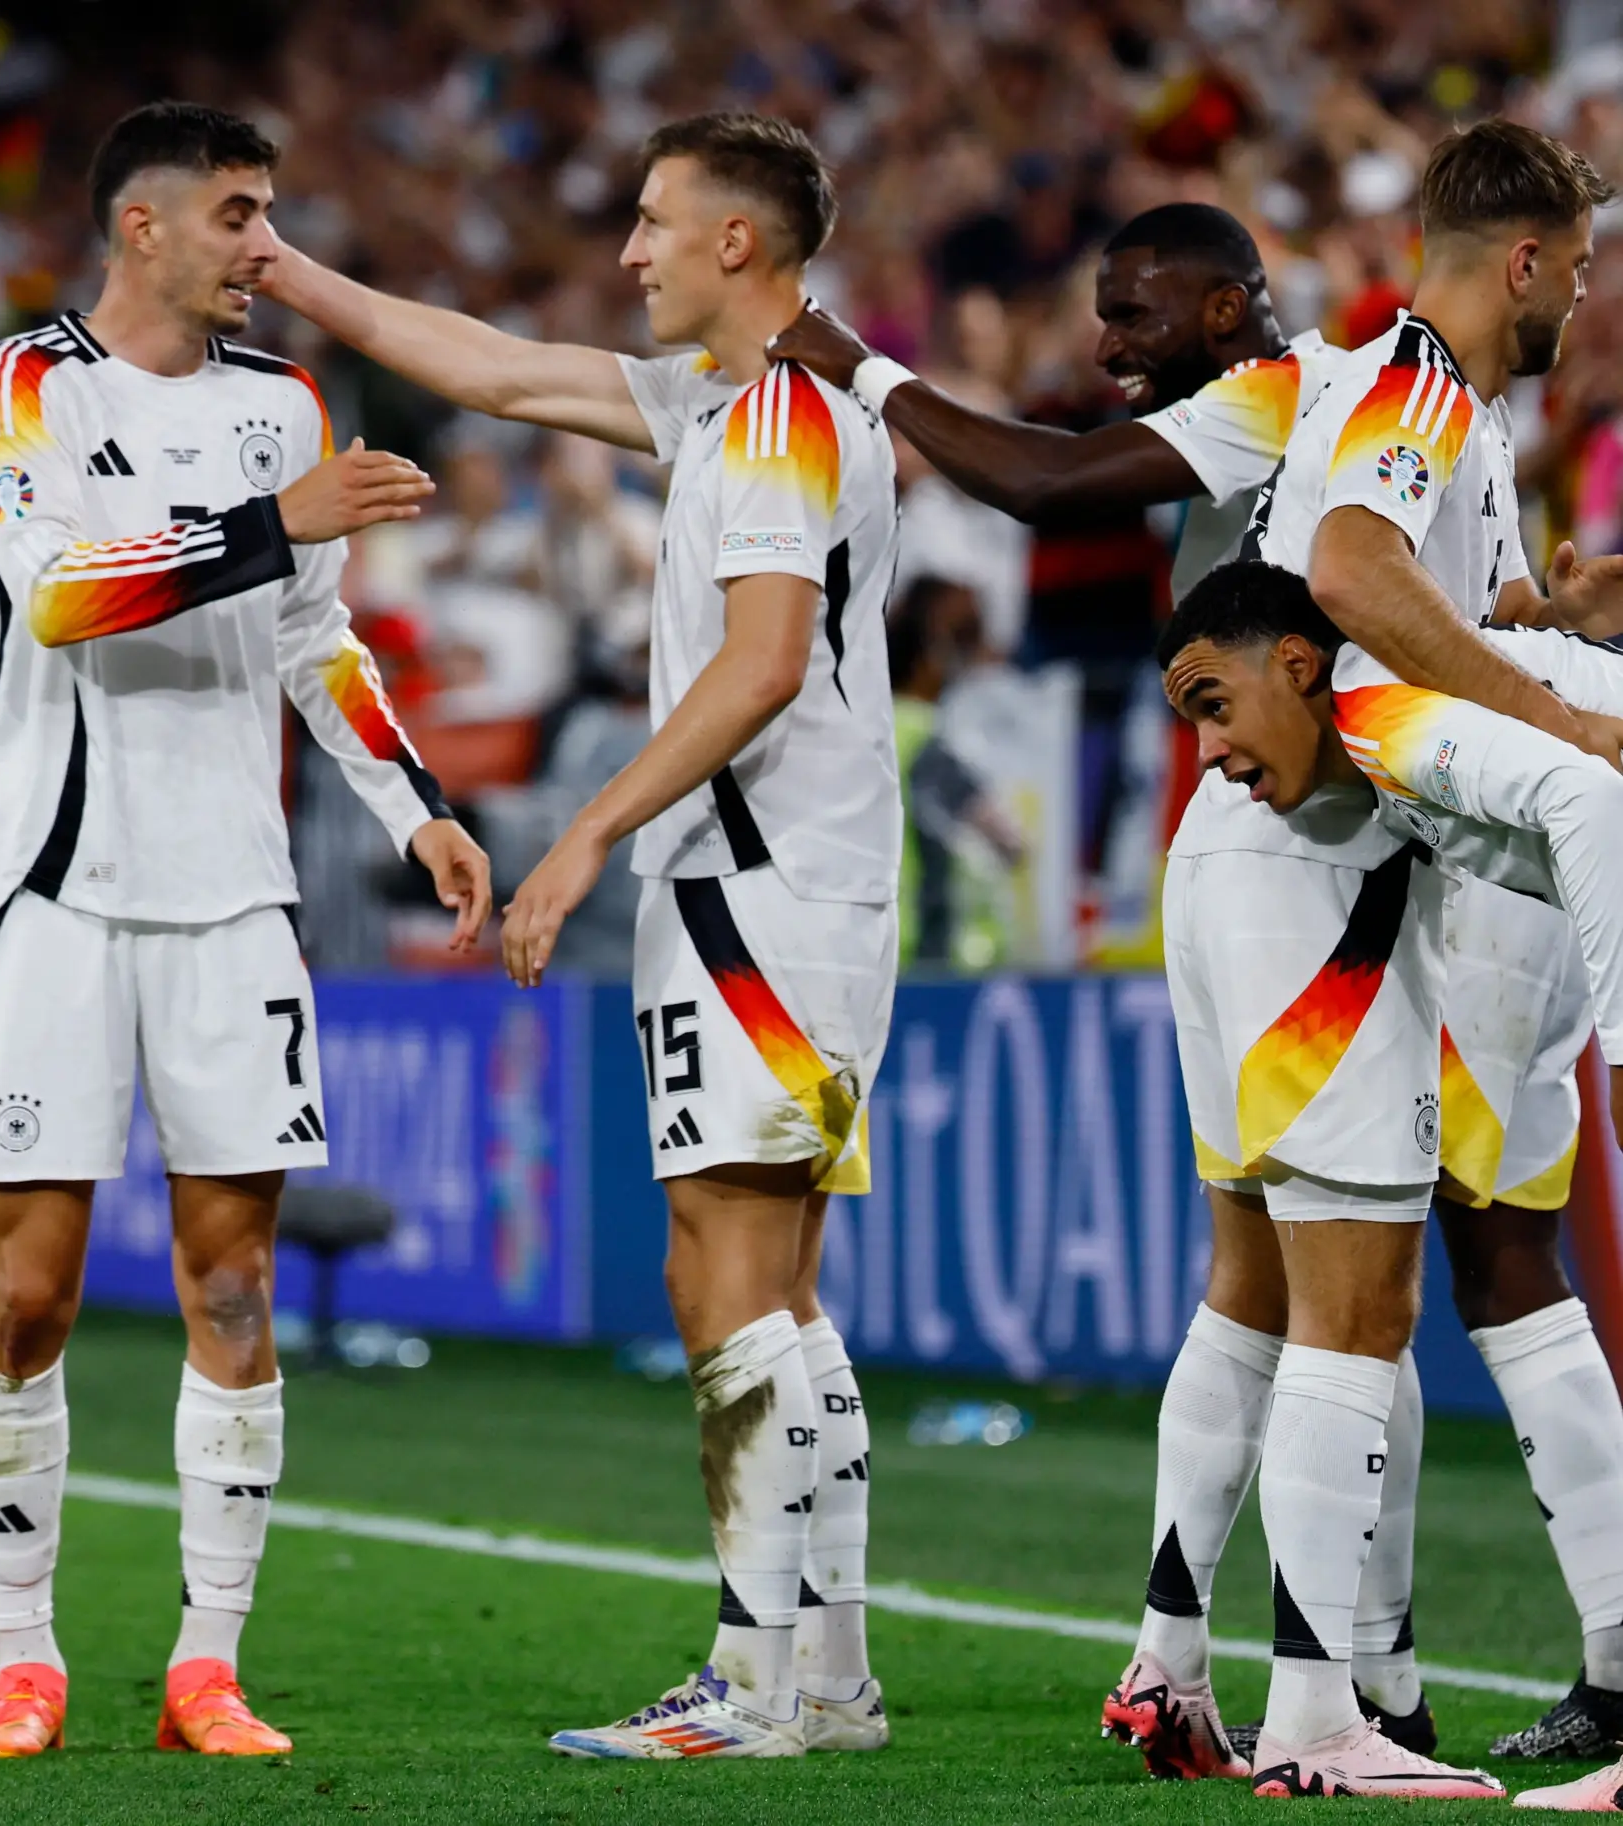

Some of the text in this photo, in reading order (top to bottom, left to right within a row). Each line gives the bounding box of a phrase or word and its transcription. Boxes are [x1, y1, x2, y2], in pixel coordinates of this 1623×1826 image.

[265, 998, 307, 1089] 7
[637, 1000, 704, 1101] 15
[955, 968, 1217, 1386] QAT
[1366, 1453, 1387, 1474] D
